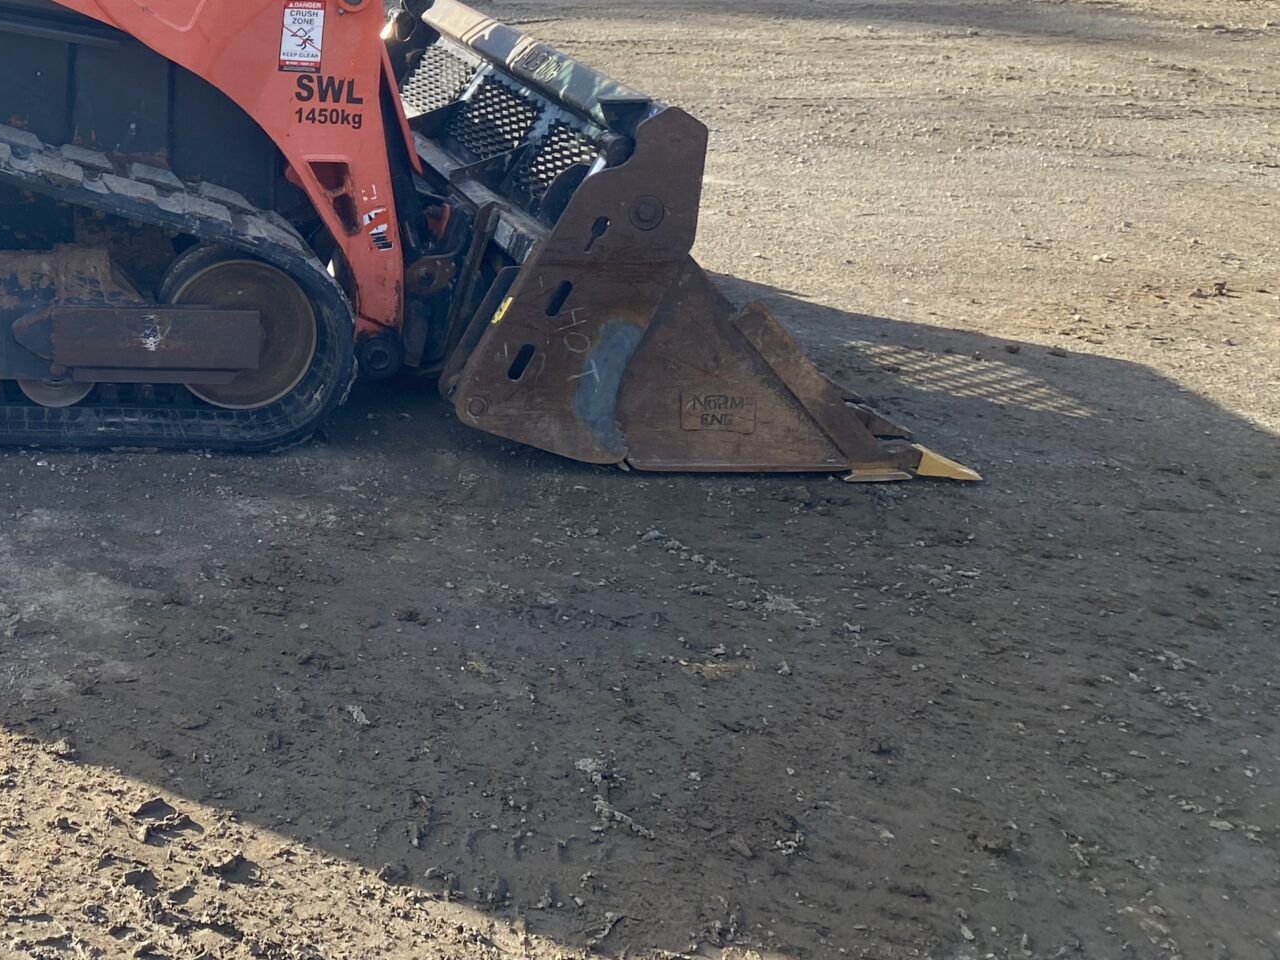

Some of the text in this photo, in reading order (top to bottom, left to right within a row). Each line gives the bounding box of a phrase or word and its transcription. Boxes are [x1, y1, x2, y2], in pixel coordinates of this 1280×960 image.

[290, 10, 319, 18] CRUSH
[292, 18, 315, 26] ZONE
[295, 74, 364, 105] SWL
[295, 108, 362, 130] 1450kg
